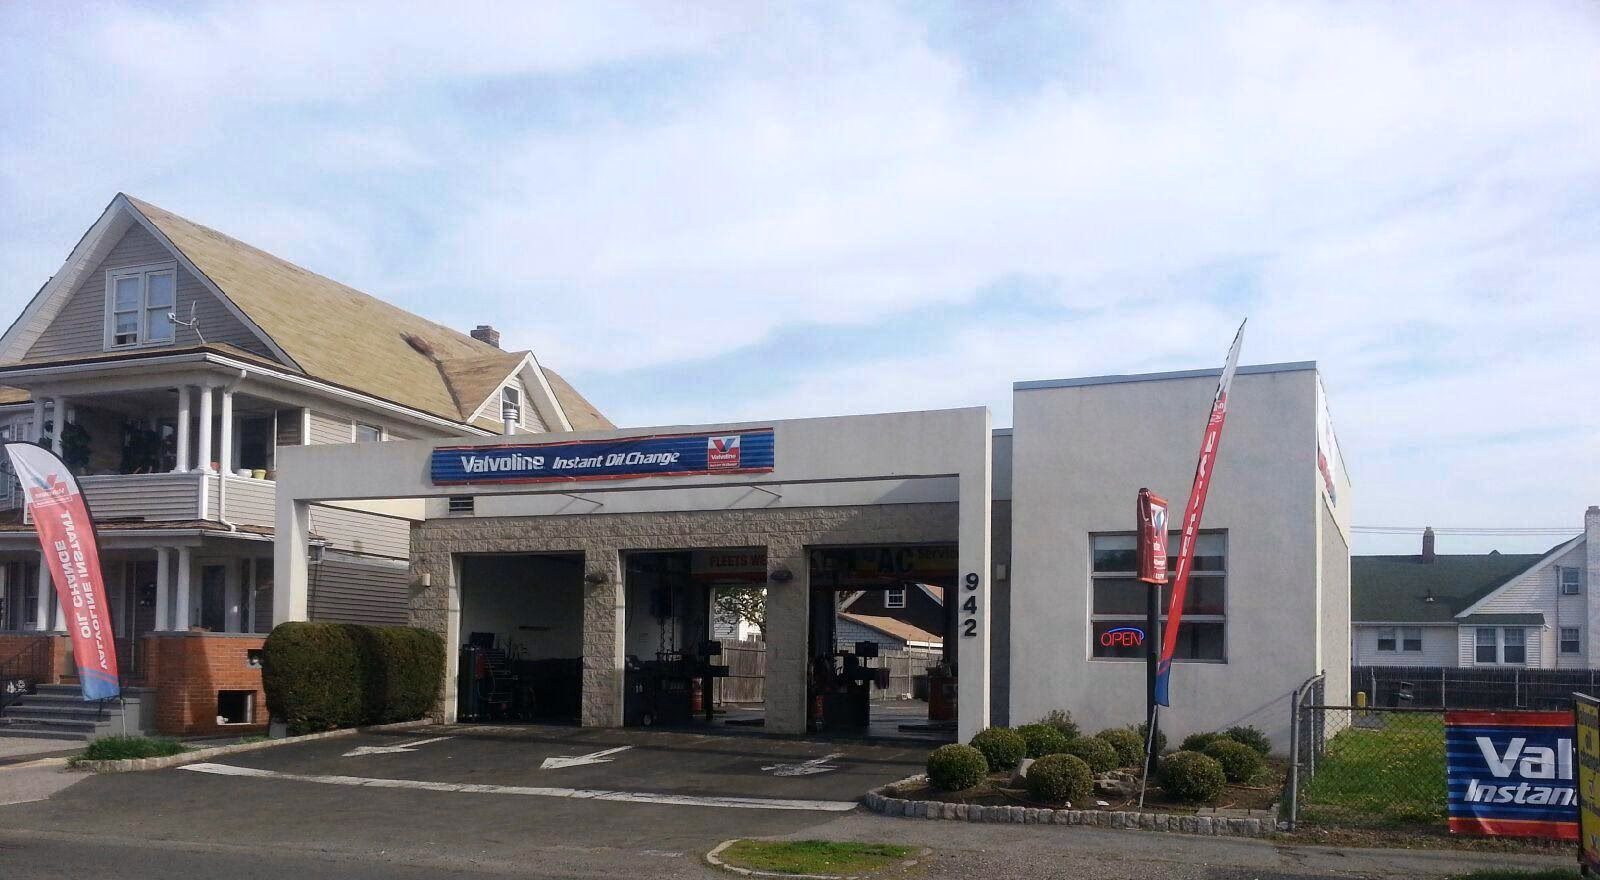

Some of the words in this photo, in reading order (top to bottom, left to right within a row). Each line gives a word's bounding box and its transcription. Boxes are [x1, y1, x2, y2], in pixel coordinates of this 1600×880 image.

[460, 453, 545, 473] Valvoline
[552, 455, 604, 470] Instant
[604, 452, 626, 467] Oil
[625, 450, 681, 467] Change
[709, 553, 748, 568] FLEETS
[963, 572, 979, 637] 942
[1100, 631, 1142, 646] OPEN
[1475, 736, 1576, 780] Val
